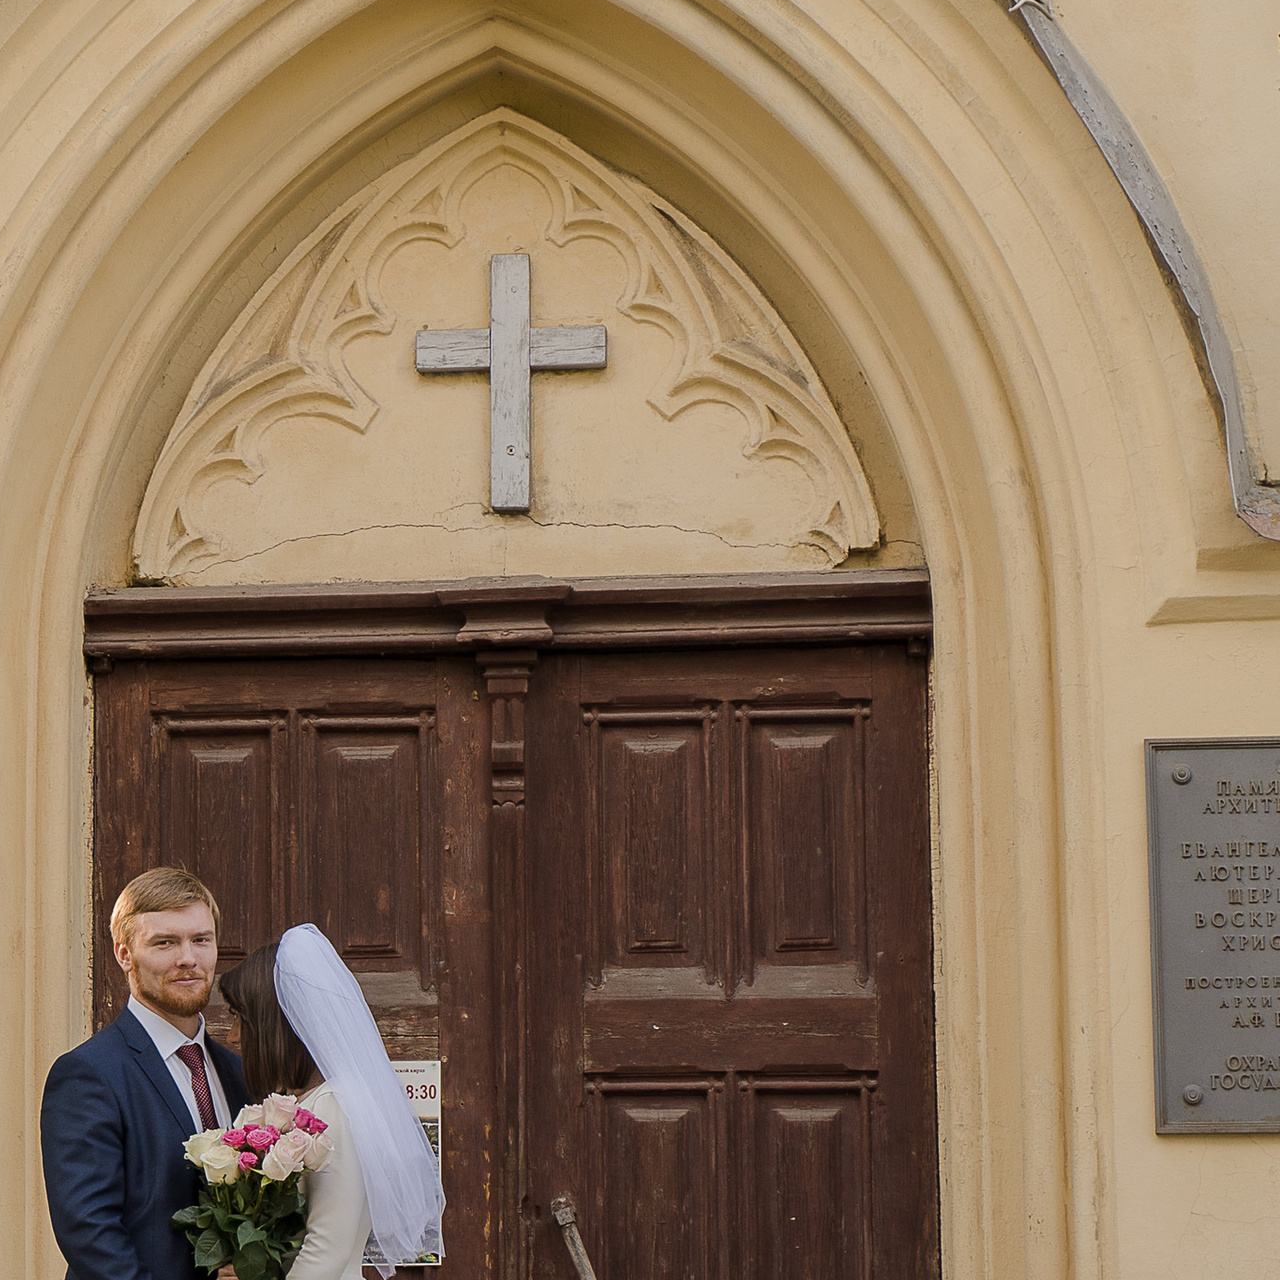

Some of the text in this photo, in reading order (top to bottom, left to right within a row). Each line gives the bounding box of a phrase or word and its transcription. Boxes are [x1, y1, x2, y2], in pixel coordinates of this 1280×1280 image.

[1194, 865, 1280, 882] ЛЮТЕР
[1228, 888, 1280, 905] ЦЕР
[1219, 995, 1280, 1009] АРХИ
[1227, 1055, 1280, 1072] ОХРА
[1210, 1074, 1280, 1092] ГОСУД
